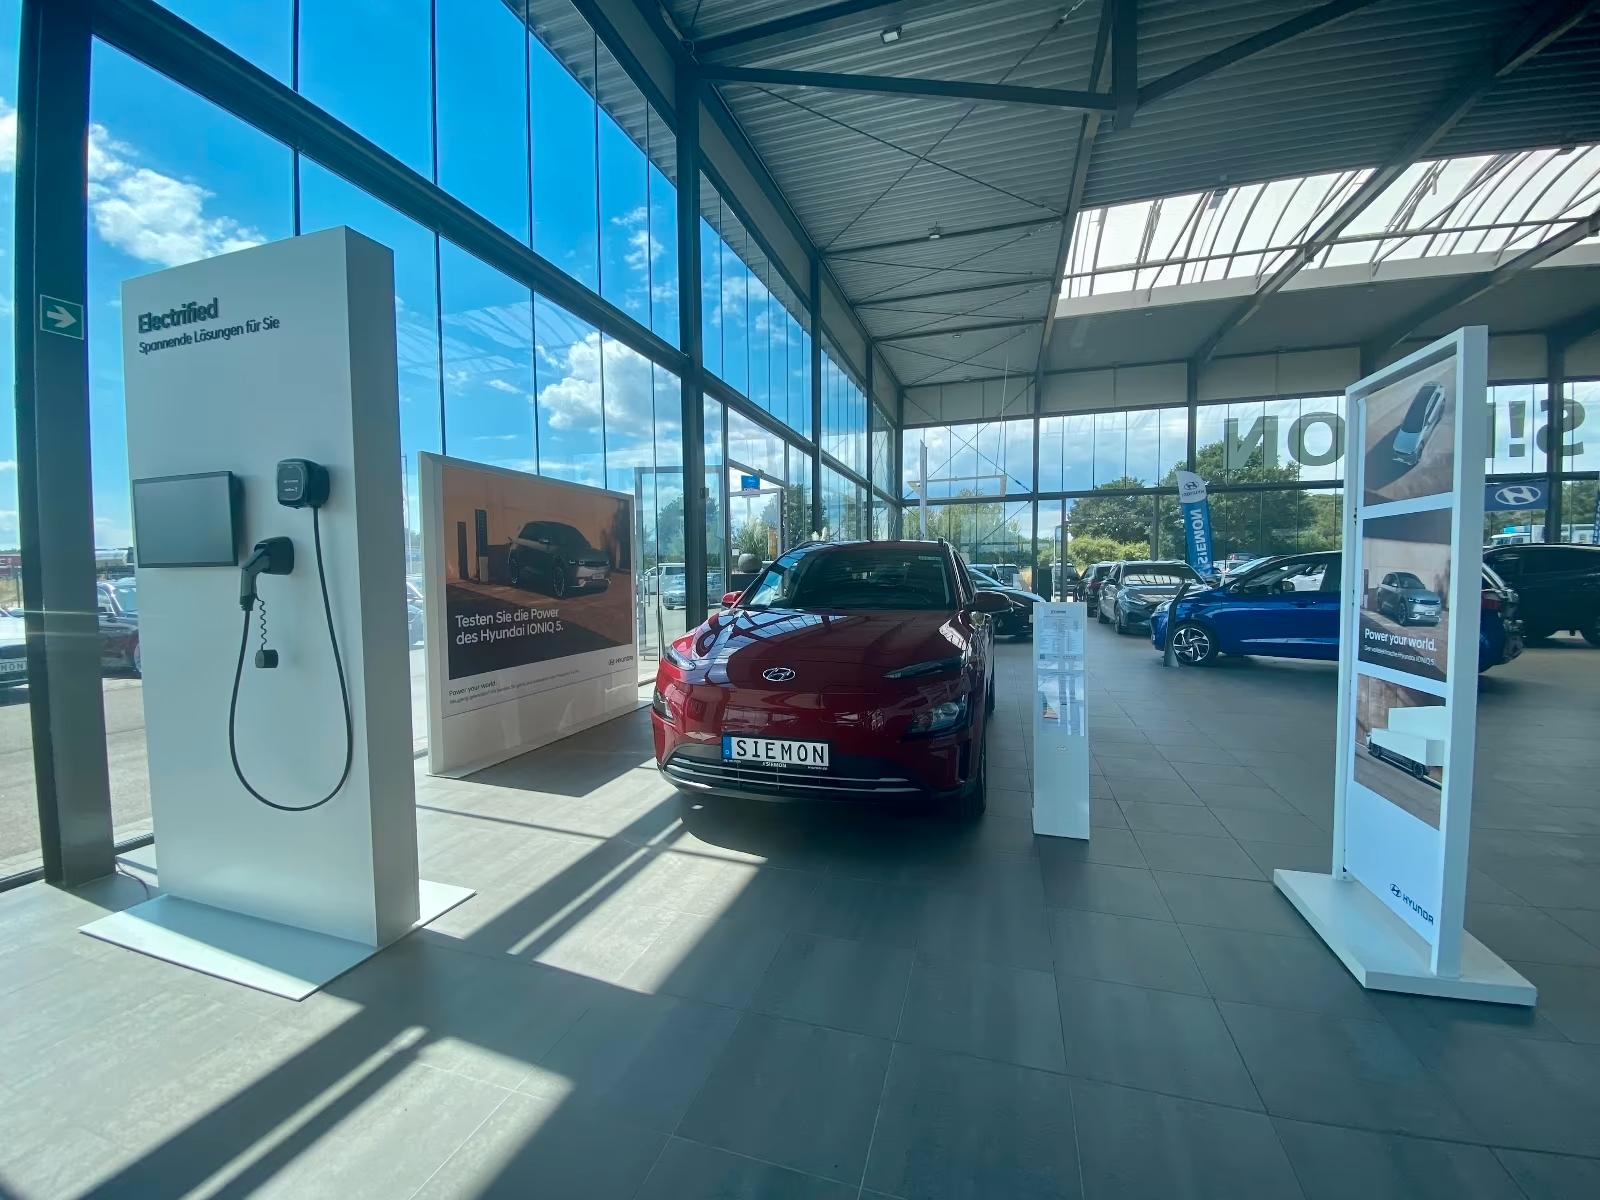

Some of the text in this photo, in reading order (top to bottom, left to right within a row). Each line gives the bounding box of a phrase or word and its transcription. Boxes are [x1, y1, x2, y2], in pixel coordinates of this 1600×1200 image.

[138, 297, 218, 333] Electrified
[139, 315, 280, 354] Spannende Lösungen für Sie
[455, 608, 559, 628] Testen Sie die Power
[456, 620, 564, 645] des Hyundai IONIQ 5.
[1364, 628, 1437, 651] Power your world.
[449, 688, 467, 696] Power
[468, 685, 480, 693] your
[736, 740, 825, 763] SIEMON
